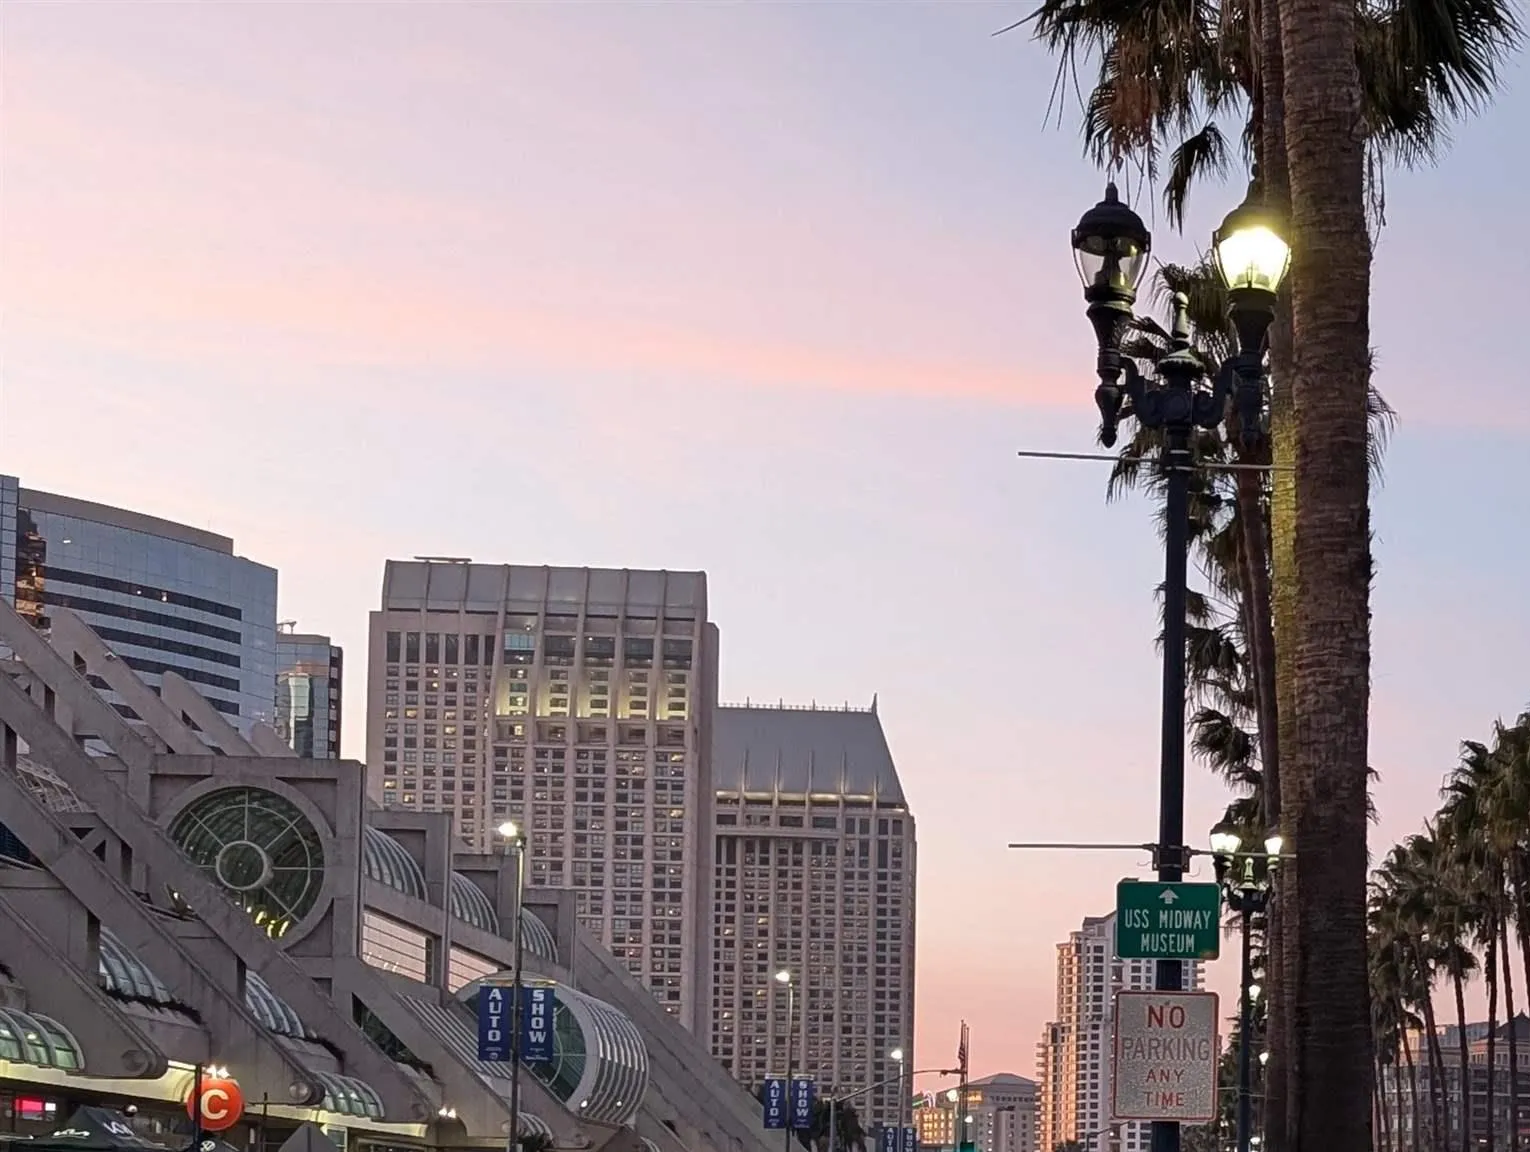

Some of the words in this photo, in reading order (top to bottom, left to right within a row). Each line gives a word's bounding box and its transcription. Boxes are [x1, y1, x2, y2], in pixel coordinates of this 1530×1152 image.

[1124, 908, 1150, 929] USS
[1159, 909, 1212, 930] MIDWAY
[1140, 933, 1195, 953] MUSEUM
[488, 988, 502, 1042] AUTO
[528, 989, 546, 1043] SHOW
[1147, 1005, 1186, 1029] NO
[1120, 1038, 1210, 1061] PARKING
[1145, 1068, 1185, 1084] ANY
[199, 1088, 229, 1120] C
[769, 1080, 780, 1116] AUTO
[796, 1080, 809, 1117] SHOW
[1143, 1092, 1185, 1107] TIME
